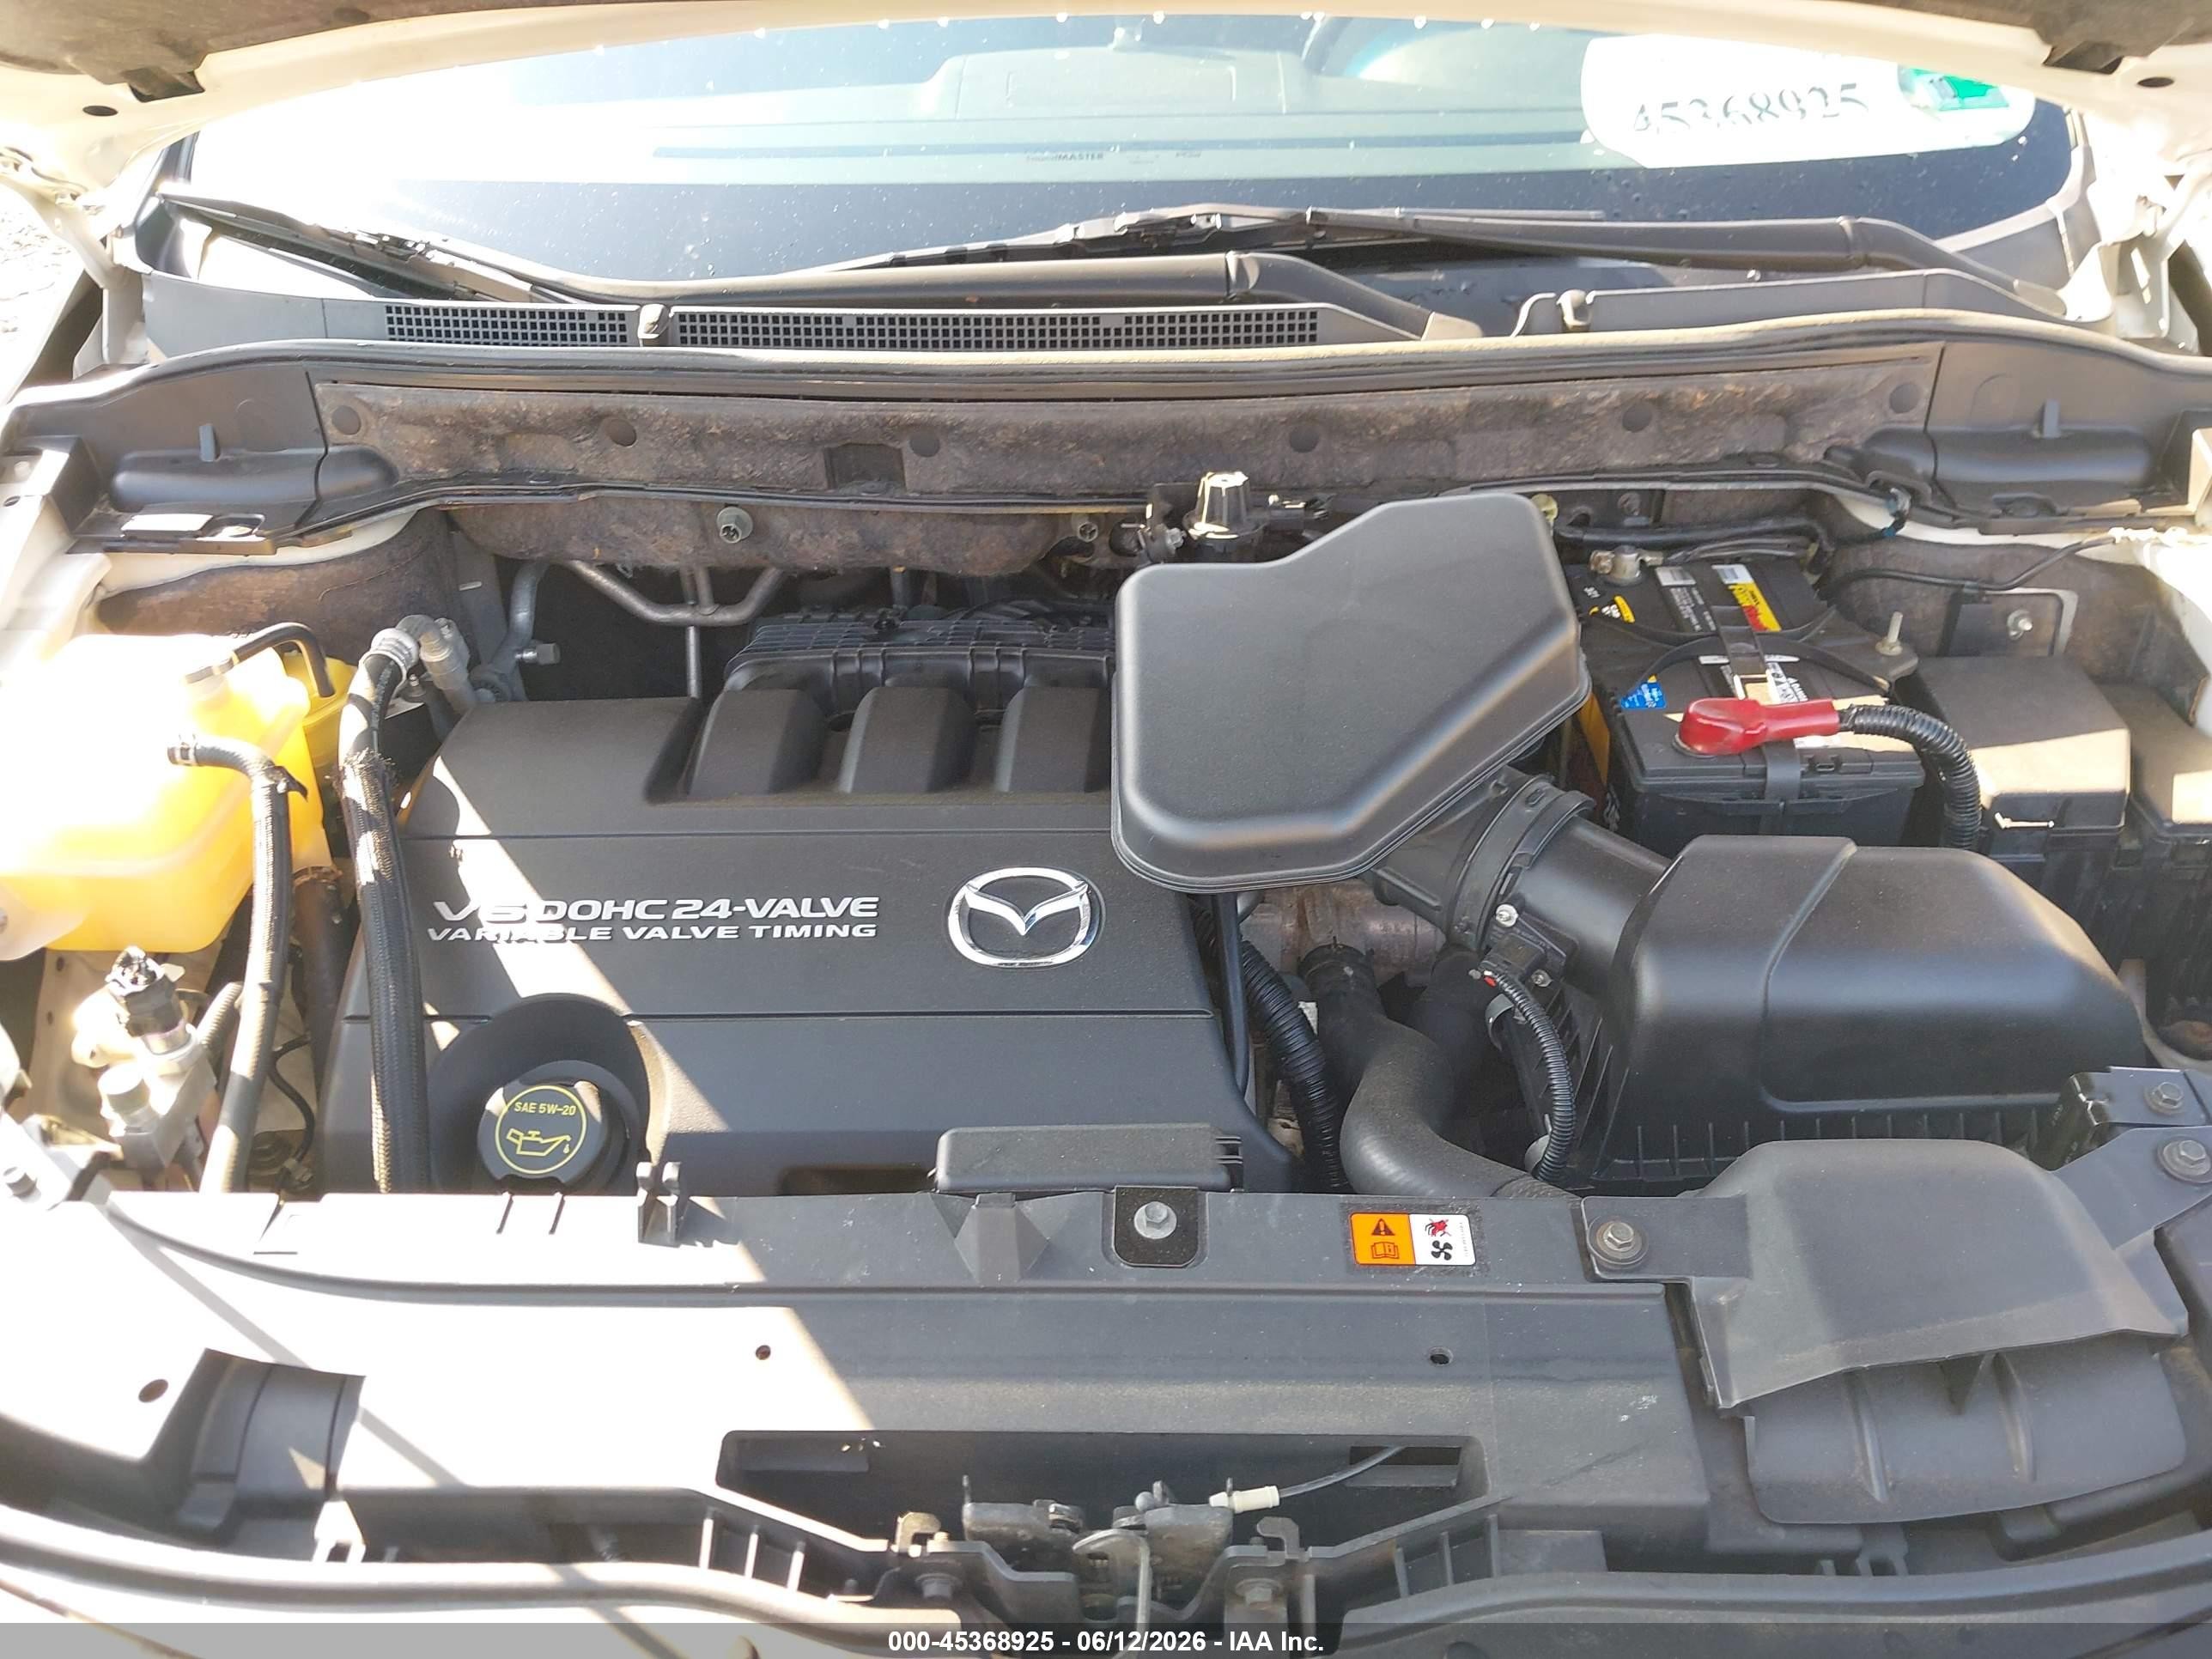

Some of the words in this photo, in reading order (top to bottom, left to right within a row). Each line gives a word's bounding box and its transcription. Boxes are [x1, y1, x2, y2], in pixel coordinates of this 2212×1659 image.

[672, 896, 879, 920] 24-VALVE
[428, 927, 612, 944] VARIABLE
[622, 925, 739, 940] VALVE
[748, 923, 877, 938] TIMING
[514, 1102, 536, 1113] SAE
[538, 1103, 576, 1115] 5W-20
